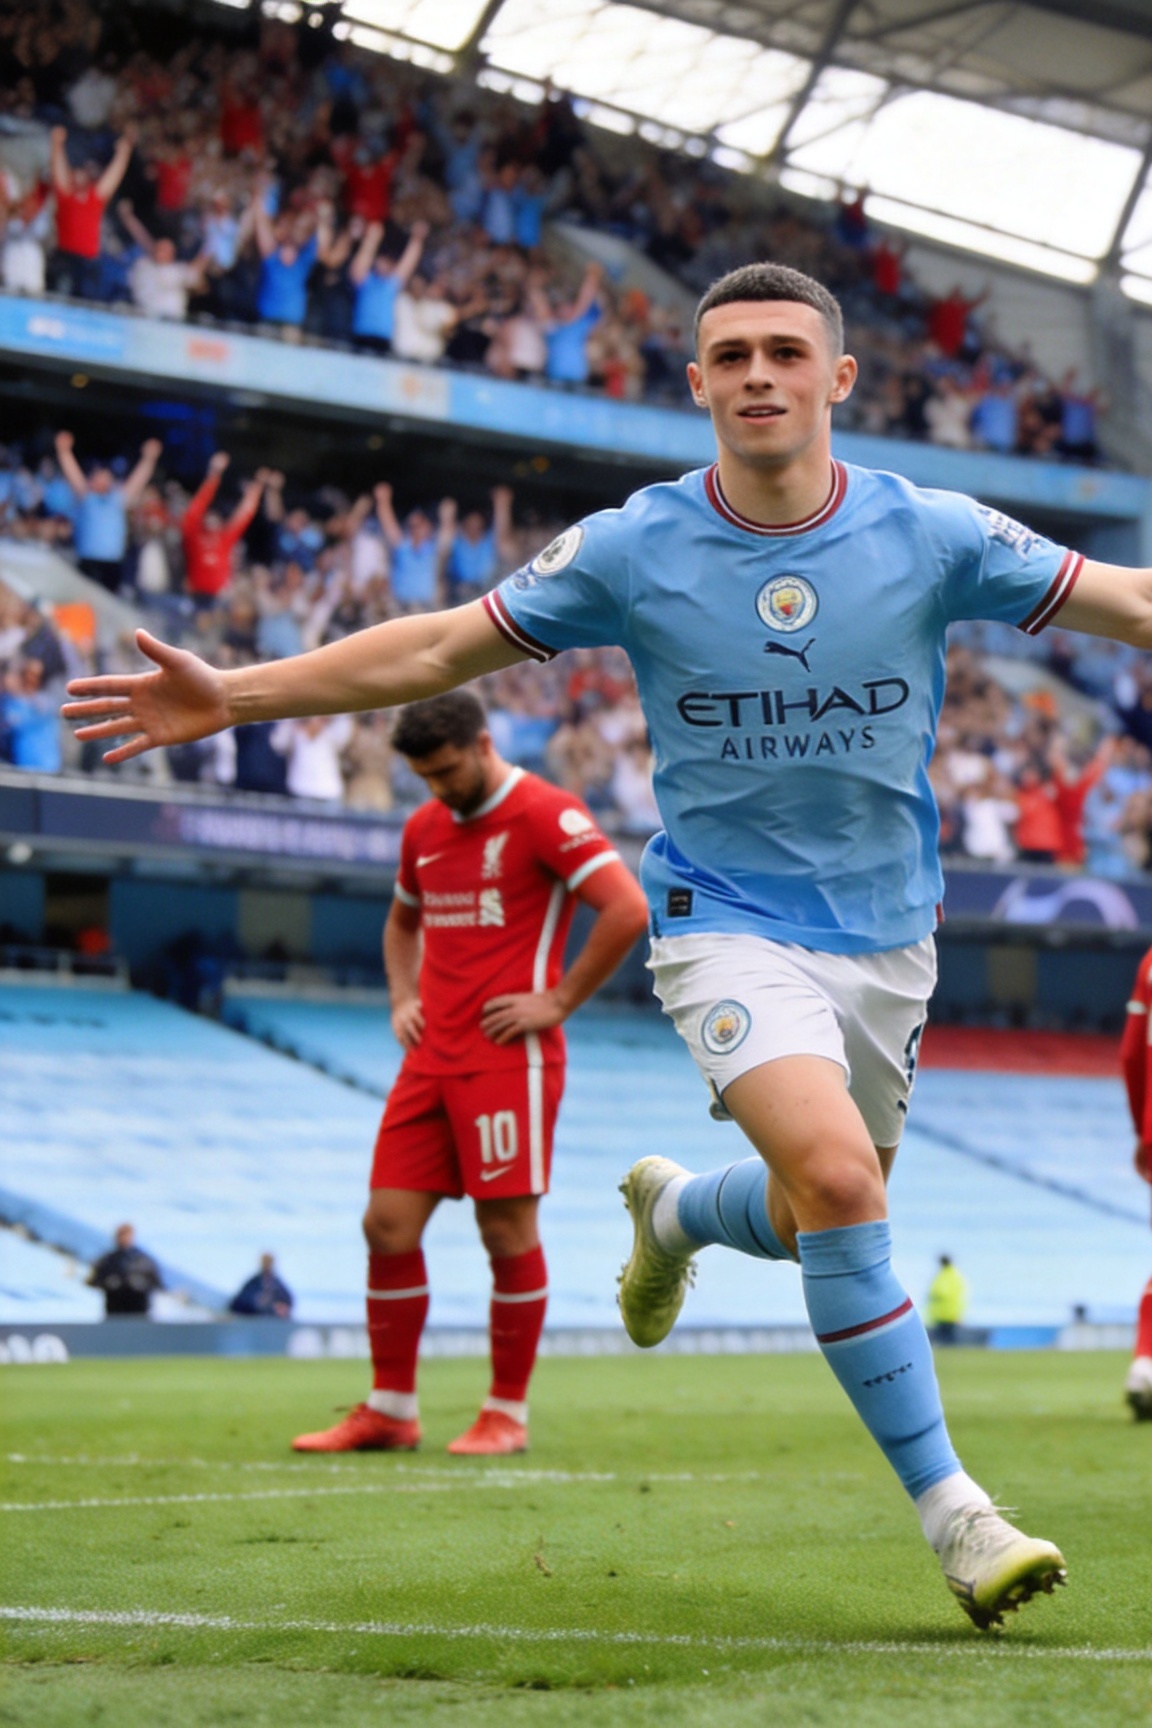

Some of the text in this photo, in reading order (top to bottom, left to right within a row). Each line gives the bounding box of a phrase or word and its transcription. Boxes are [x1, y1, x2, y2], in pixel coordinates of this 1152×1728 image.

[677, 677, 910, 727] ETIHAD
[720, 725, 876, 760] AIRWAYS
[474, 1109, 518, 1163] 10
